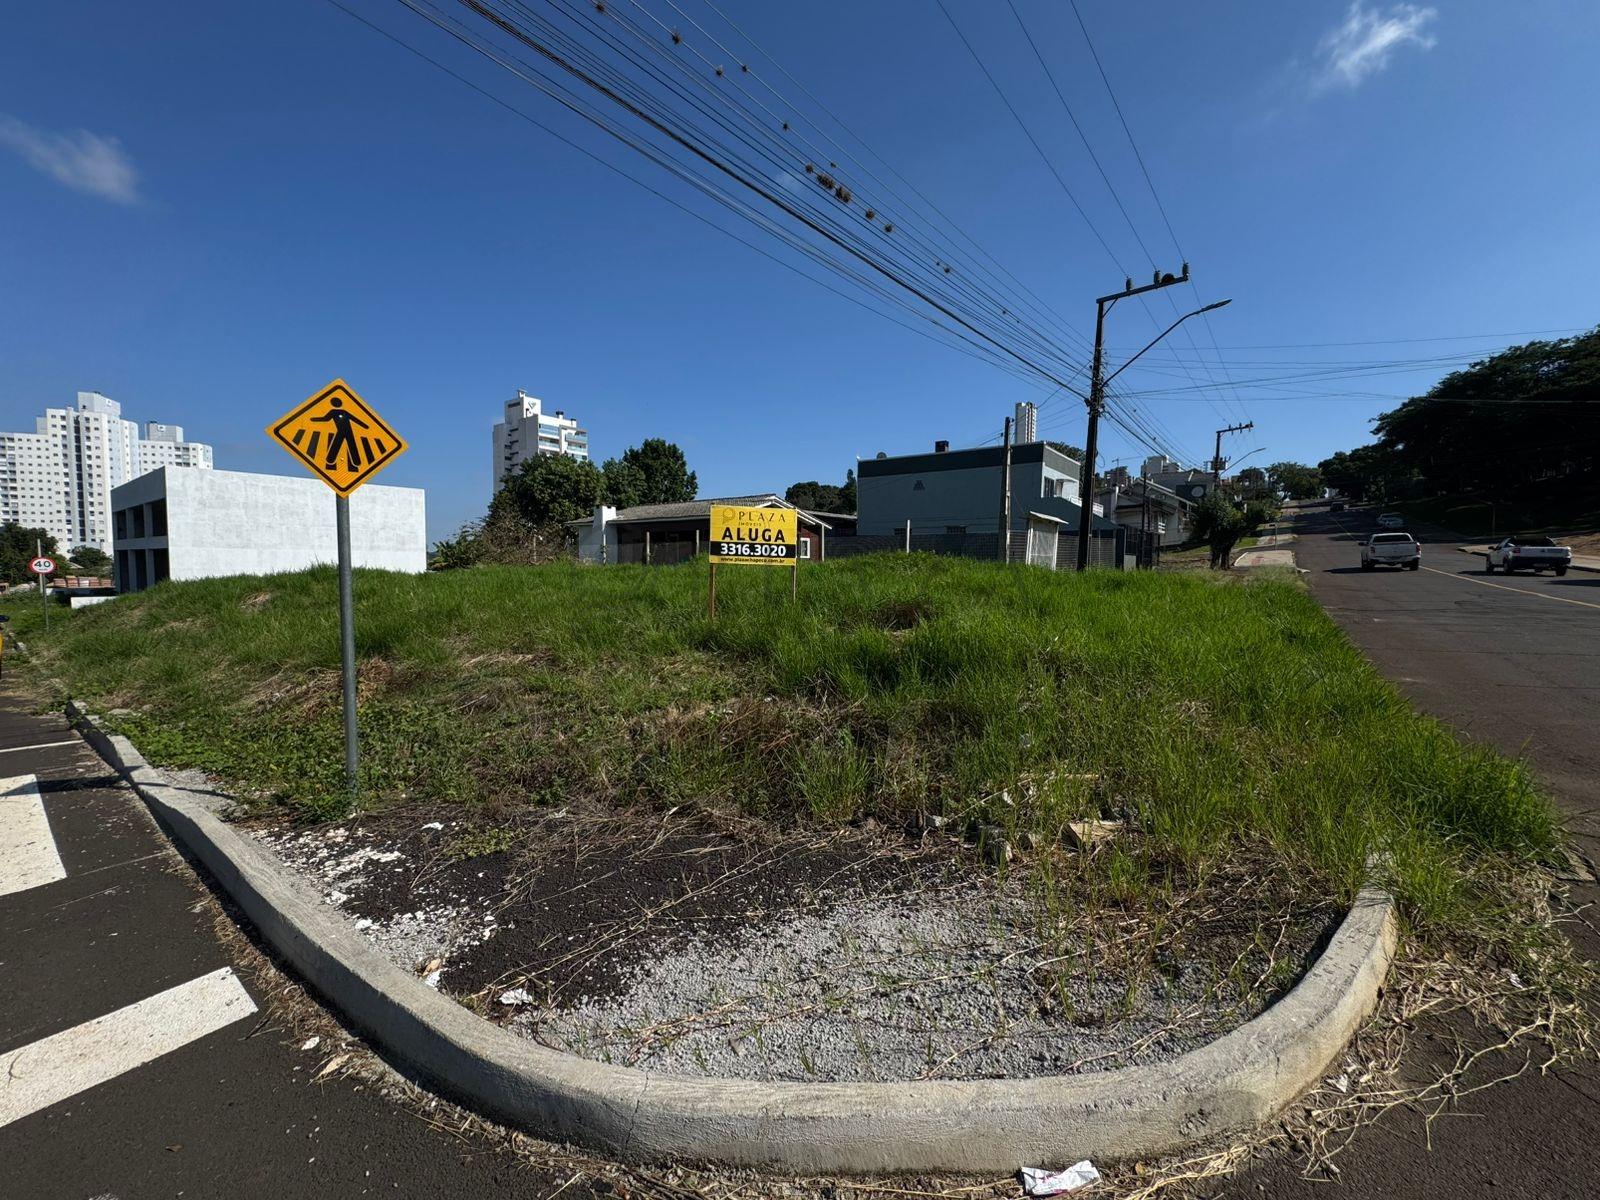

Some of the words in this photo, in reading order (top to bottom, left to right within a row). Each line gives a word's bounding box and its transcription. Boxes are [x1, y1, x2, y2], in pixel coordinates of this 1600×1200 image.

[738, 511, 785, 522] PLAZA
[722, 527, 785, 542] ALUGA
[720, 543, 786, 556] 3316.3020
